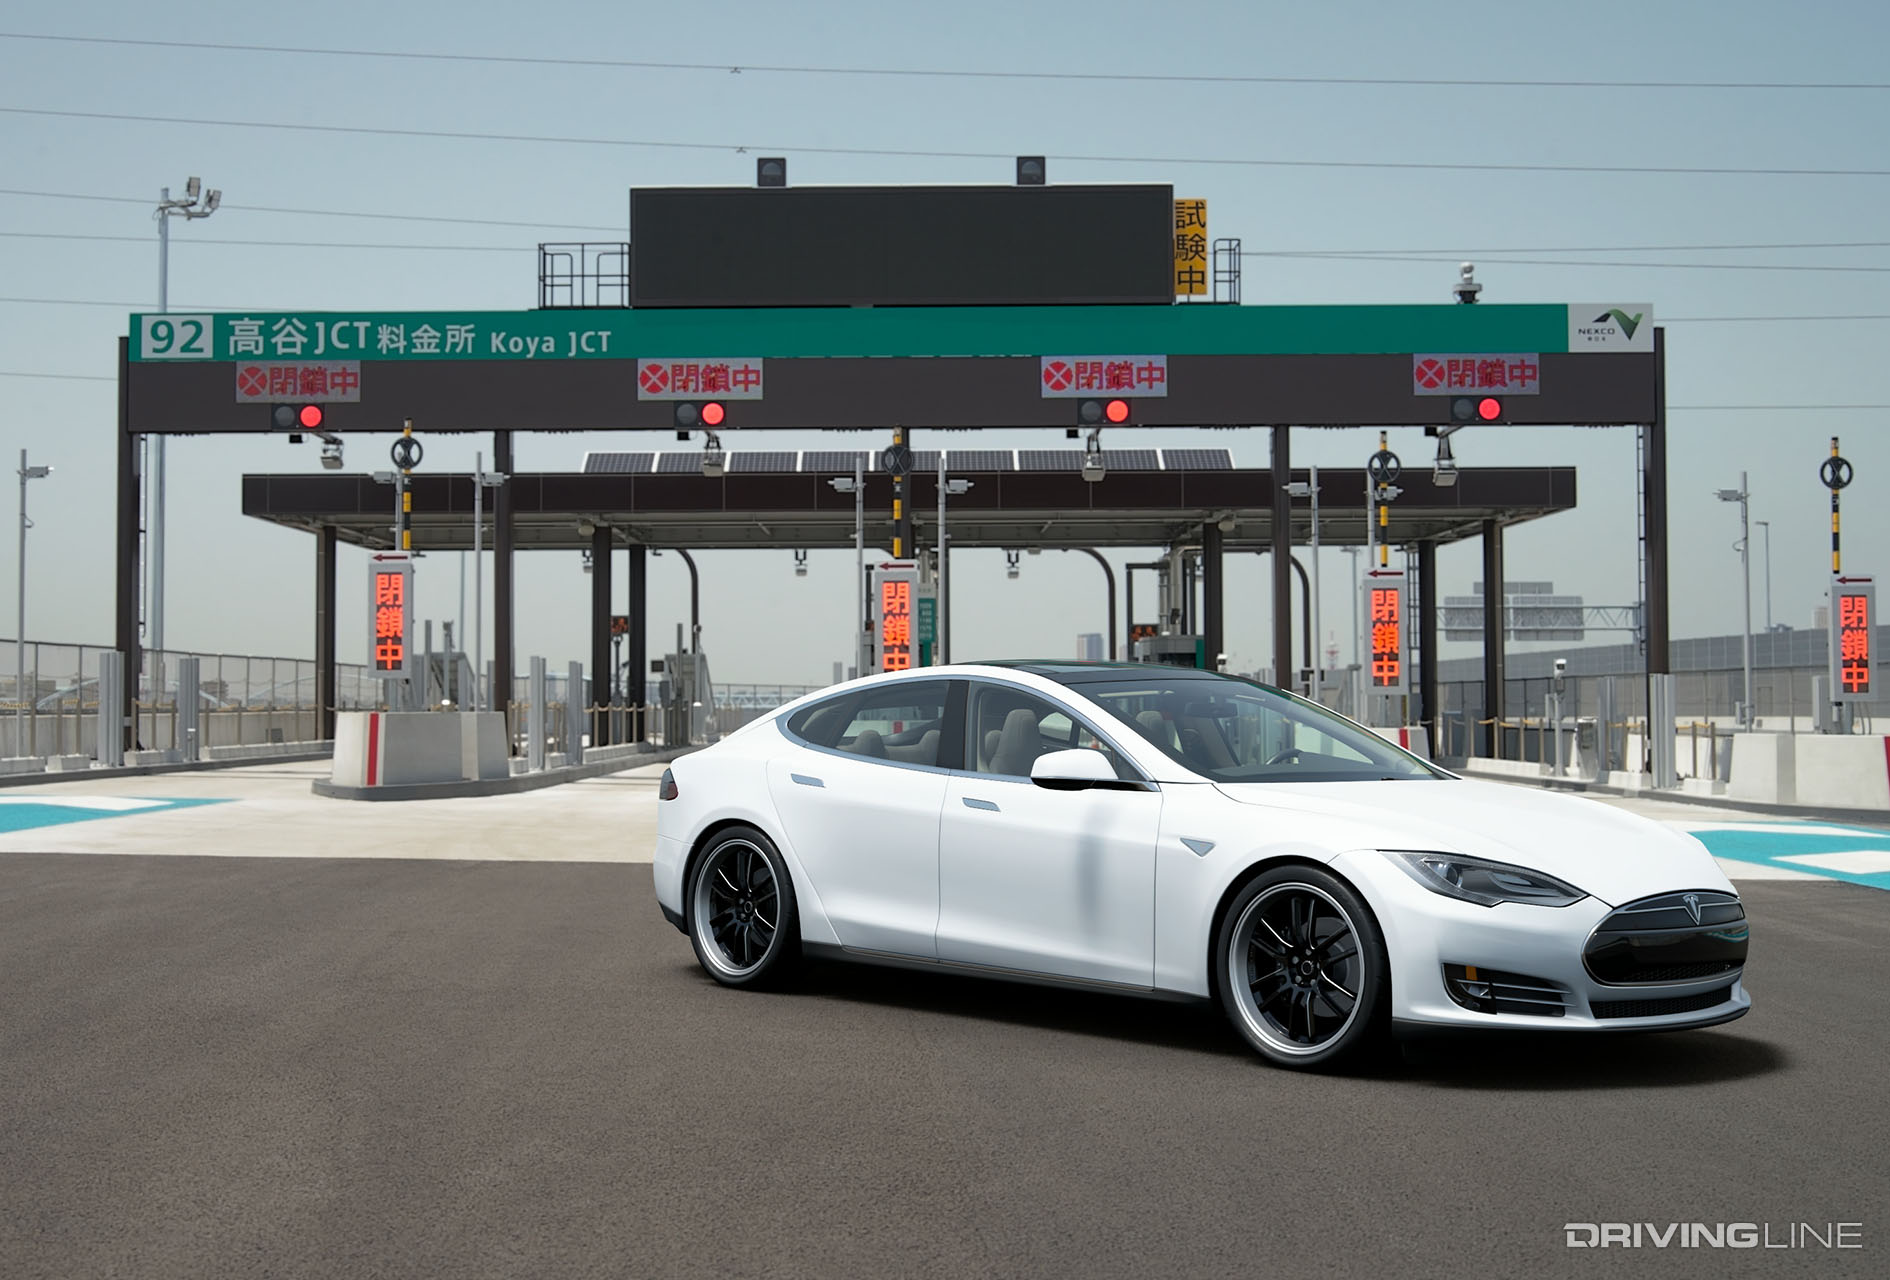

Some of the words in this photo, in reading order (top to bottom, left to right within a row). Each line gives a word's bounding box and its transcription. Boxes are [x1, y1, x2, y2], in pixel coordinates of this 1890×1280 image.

[1175, 201, 1207, 294] 試験中
[150, 319, 205, 354] 92
[490, 331, 556, 359] Koya
[567, 330, 612, 358] JCT
[1577, 327, 1616, 335] NEXCO
[269, 366, 359, 396] 閉鎖中
[671, 363, 761, 393] 閉鎖中
[1075, 360, 1165, 391] 閉鎖中
[1447, 358, 1538, 388] 閉鎖中
[376, 573, 404, 671] 閉鎖中
[1371, 589, 1400, 686] 閉鎖中
[1840, 596, 1869, 693] 閉鎖中
